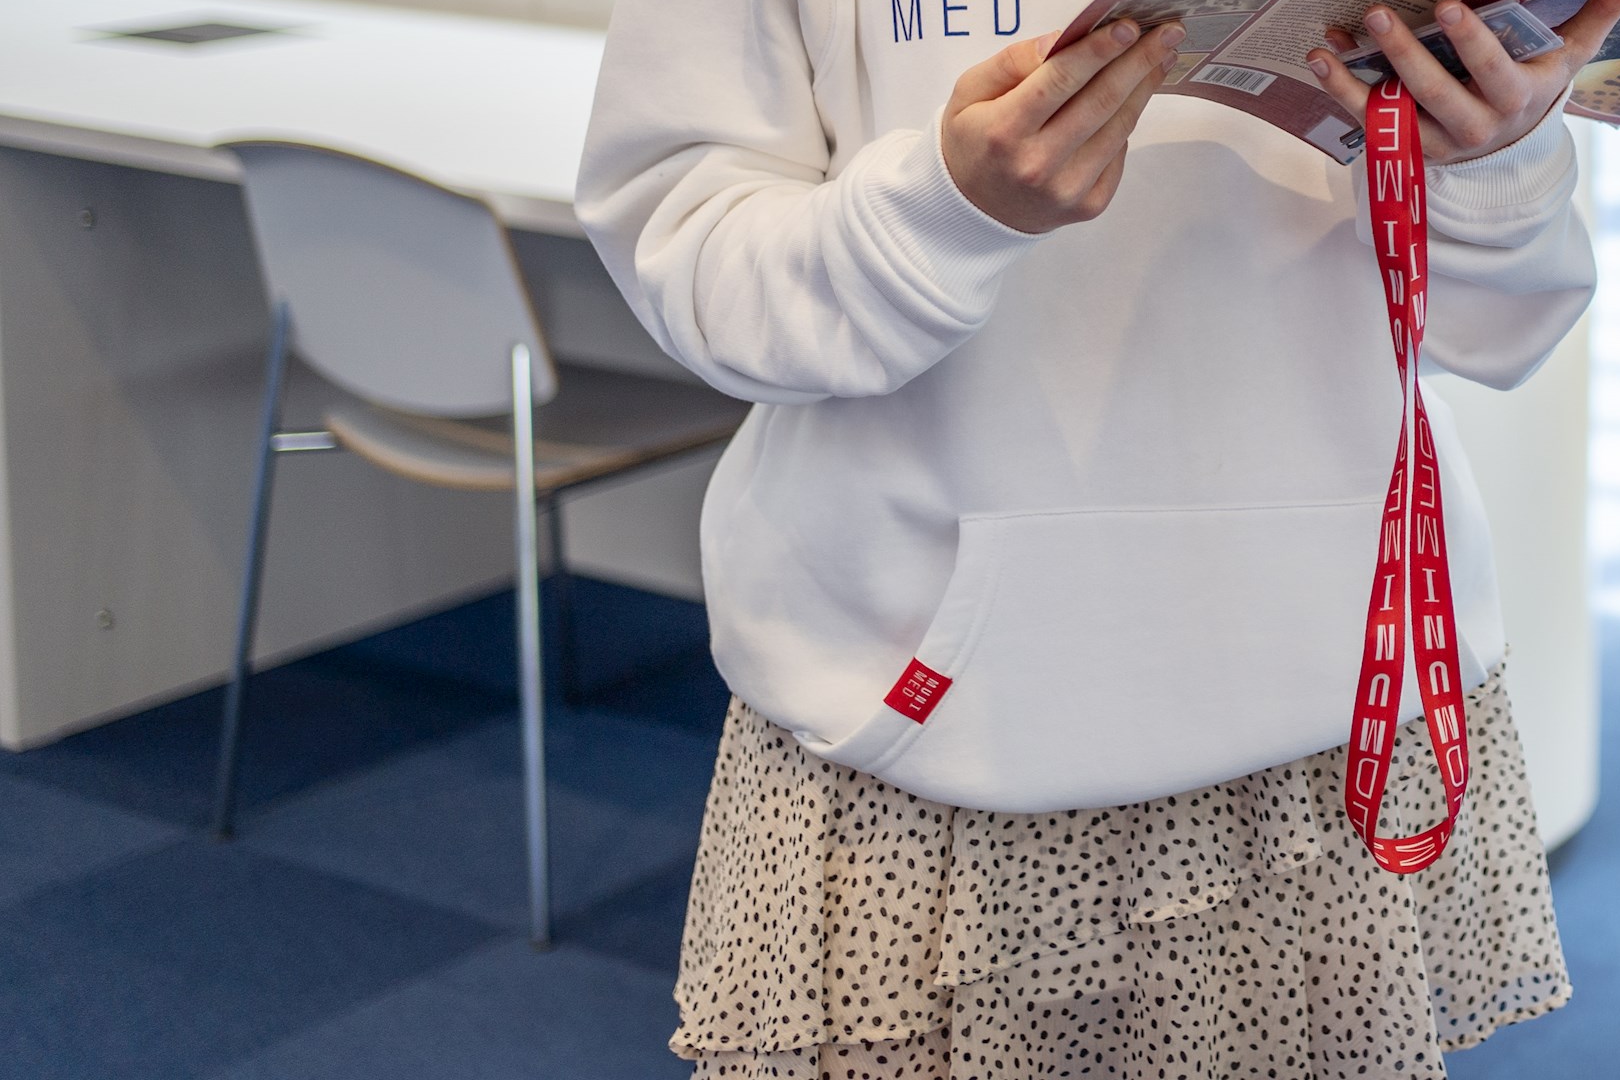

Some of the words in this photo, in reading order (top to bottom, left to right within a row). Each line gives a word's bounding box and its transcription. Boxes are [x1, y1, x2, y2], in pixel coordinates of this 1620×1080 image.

[902, 669, 928, 698] MED
[908, 677, 940, 712] MUNI
[1359, 573, 1396, 756] MUNI
[1421, 568, 1460, 745] MUNI
